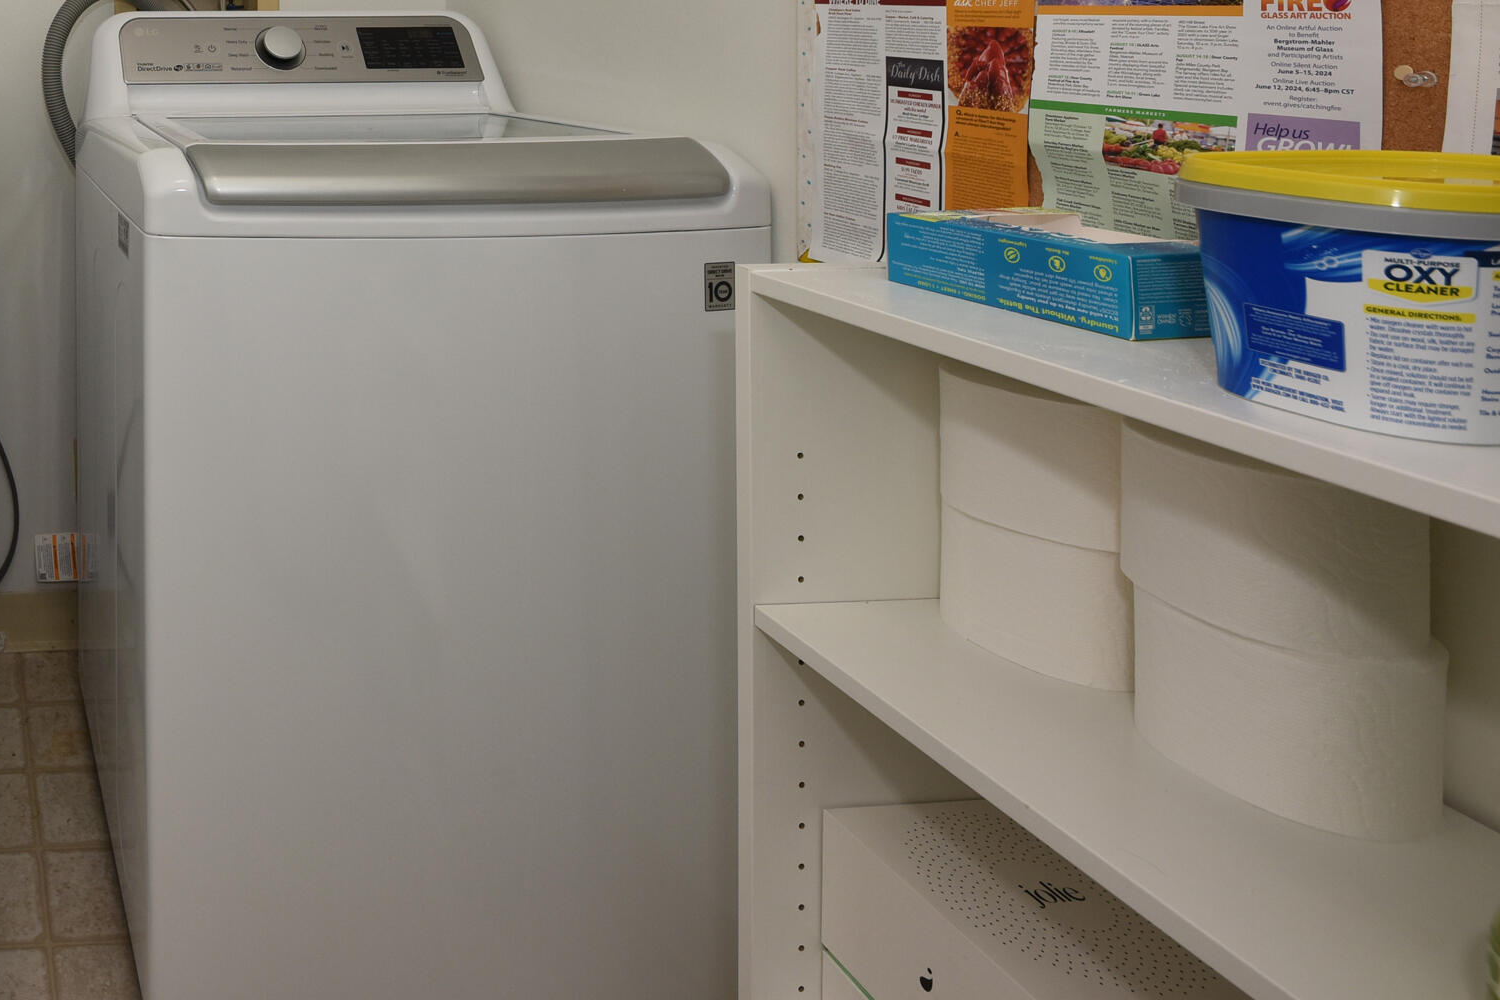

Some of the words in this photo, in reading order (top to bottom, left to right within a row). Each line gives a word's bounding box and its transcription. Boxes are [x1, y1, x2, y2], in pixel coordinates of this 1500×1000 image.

[1310, 12, 1352, 20] AUCTION
[1274, 38, 1335, 46] Bergstrom-Mahler
[1281, 52, 1321, 60] Participating
[890, 63, 916, 85] Daily
[918, 66, 941, 82] Dish
[1255, 83, 1272, 91] June
[1284, 85, 1304, 93] 2024,
[1263, 101, 1342, 111] event.gives/catchingfire
[1253, 122, 1290, 140] Help
[1292, 128, 1310, 139] us
[1384, 257, 1460, 268] MULTI-PURPOSE
[1384, 264, 1460, 286] OXY
[1384, 282, 1460, 296] CLEANER
[1024, 304, 1039, 314] The
[1366, 306, 1406, 317] GENERAL
[1042, 309, 1076, 322] Without
[1017, 881, 1086, 909] jolie
